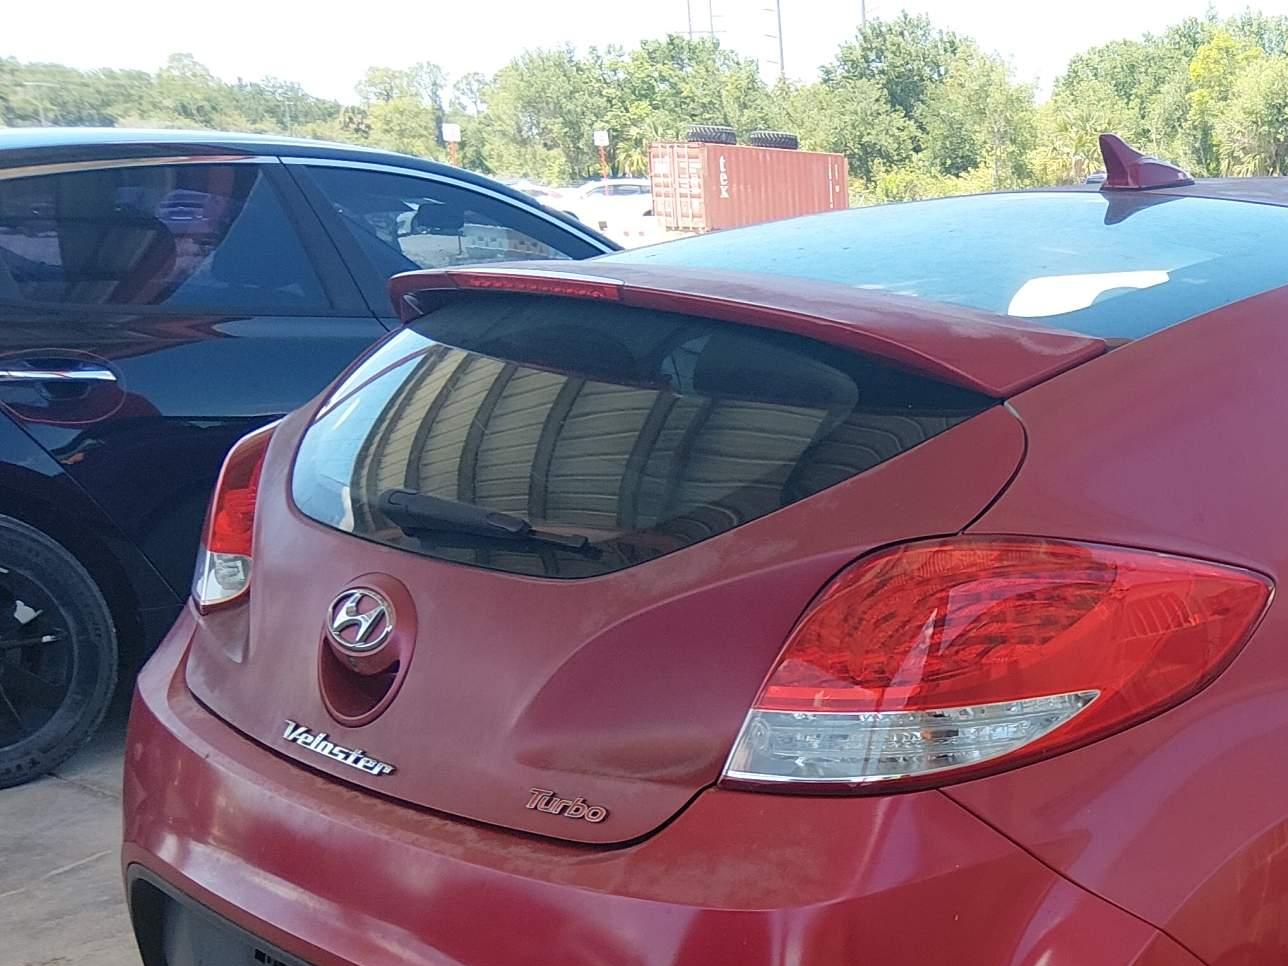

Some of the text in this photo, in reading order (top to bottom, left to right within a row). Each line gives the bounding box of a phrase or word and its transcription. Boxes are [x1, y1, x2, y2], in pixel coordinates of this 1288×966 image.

[719, 155, 729, 199] tex
[282, 719, 395, 775] Veloster
[526, 787, 607, 823] Turbo
